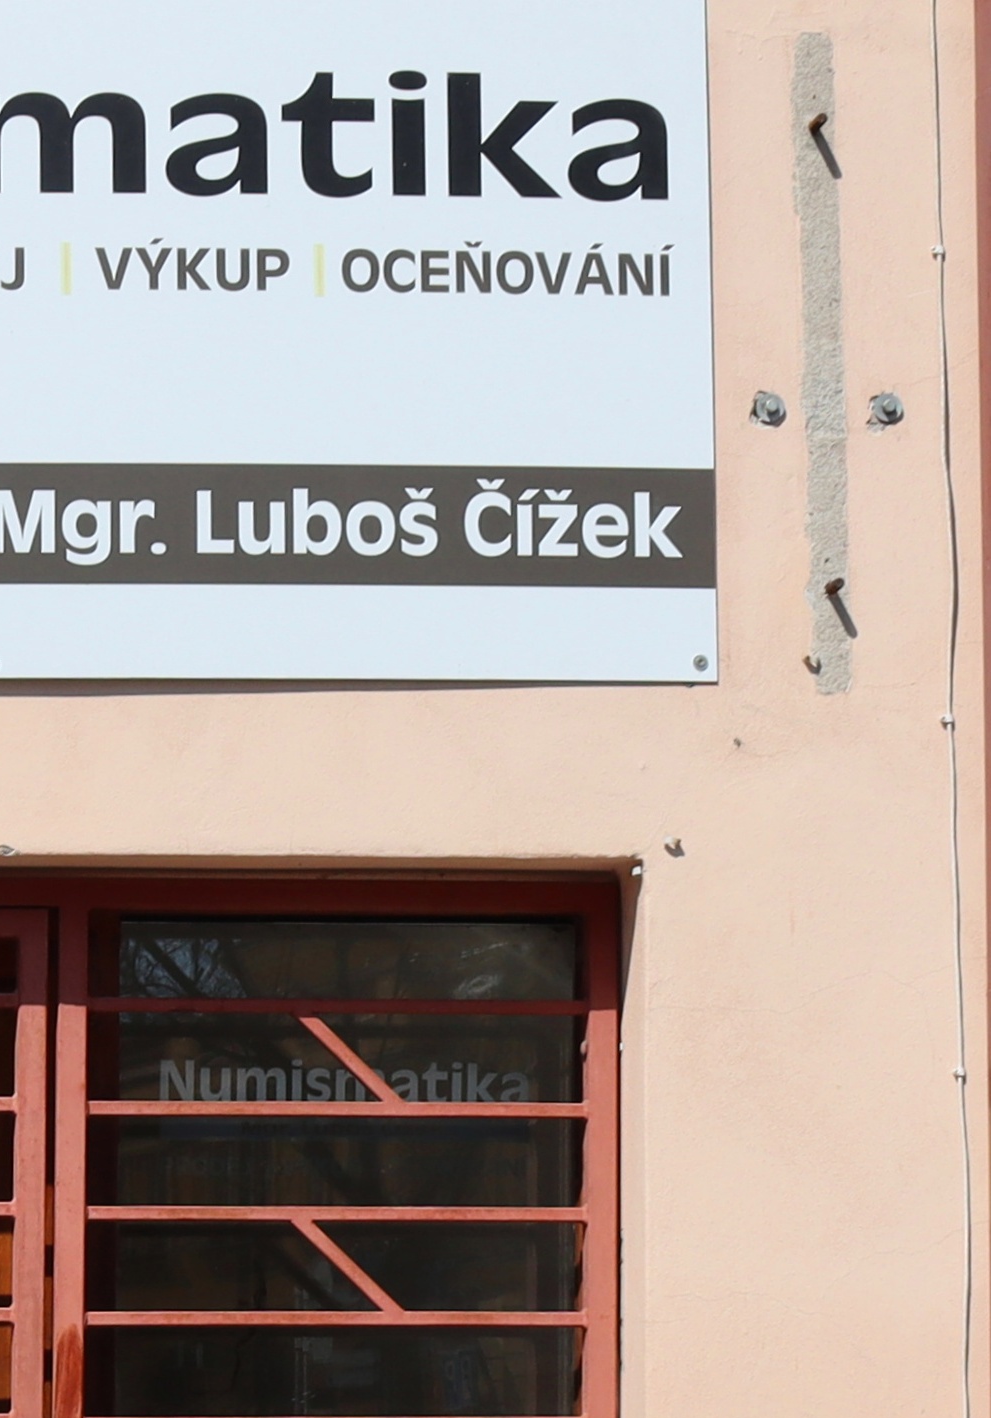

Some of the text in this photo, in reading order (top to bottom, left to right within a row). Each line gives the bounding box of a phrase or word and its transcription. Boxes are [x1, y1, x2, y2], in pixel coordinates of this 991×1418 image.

[96, 238, 292, 292] VÝKUP
[341, 240, 675, 297] OCEŇOVÁNÍ
[196, 487, 440, 558] Luboš
[464, 478, 683, 560] Čížek
